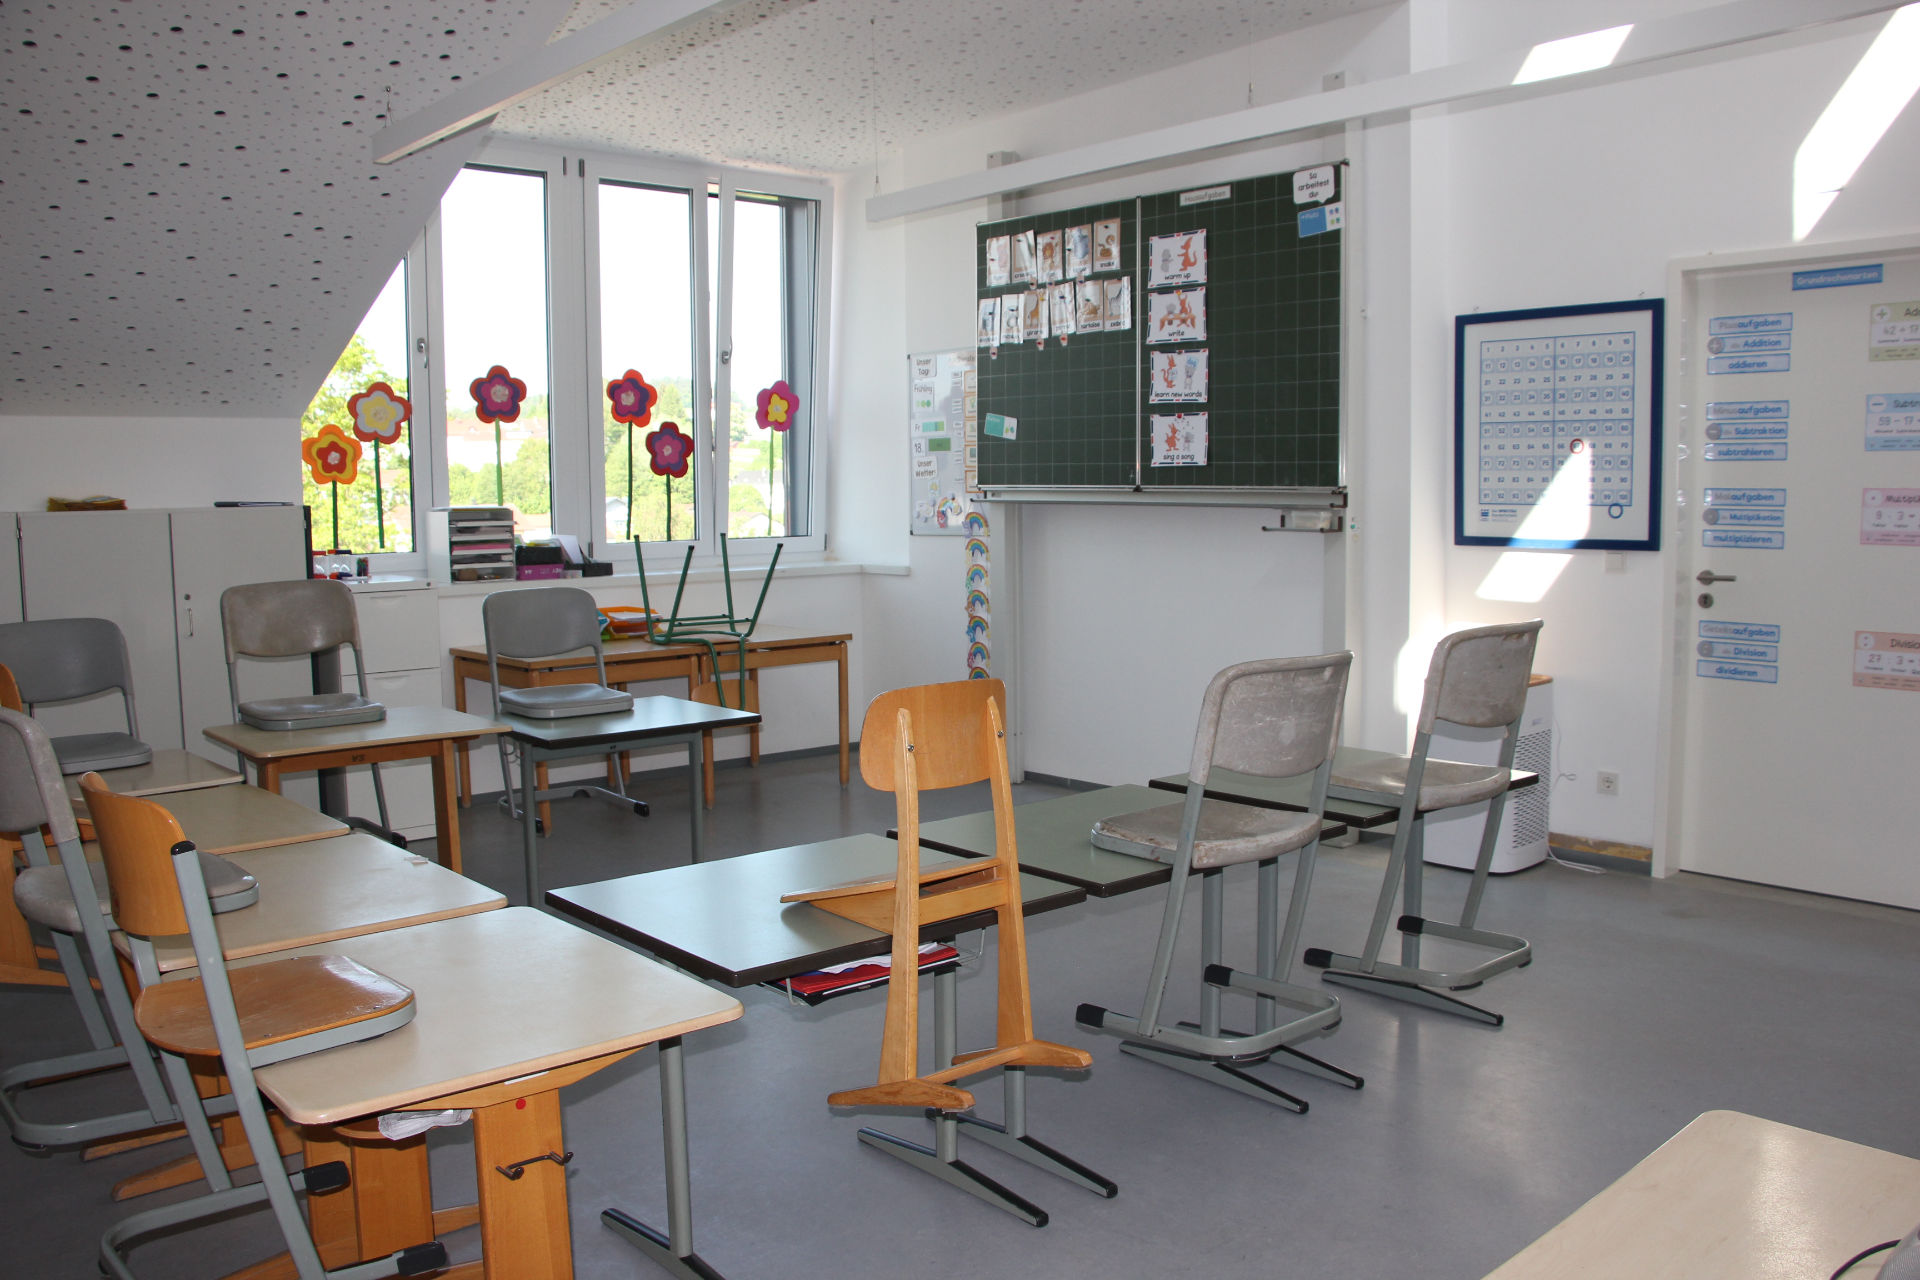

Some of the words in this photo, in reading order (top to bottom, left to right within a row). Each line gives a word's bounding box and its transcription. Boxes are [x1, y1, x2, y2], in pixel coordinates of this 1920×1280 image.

[1298, 179, 1330, 192] arbeitest
[1183, 272, 1191, 280] up
[1743, 338, 1782, 348] Addition
[1728, 360, 1768, 369] addieren
[1735, 426, 1785, 435] Subtraktion
[1718, 448, 1774, 456] subtrahieren
[1713, 534, 1773, 543] multiplizieren
[1734, 647, 1767, 656] Division
[1716, 666, 1758, 676] dividieren
